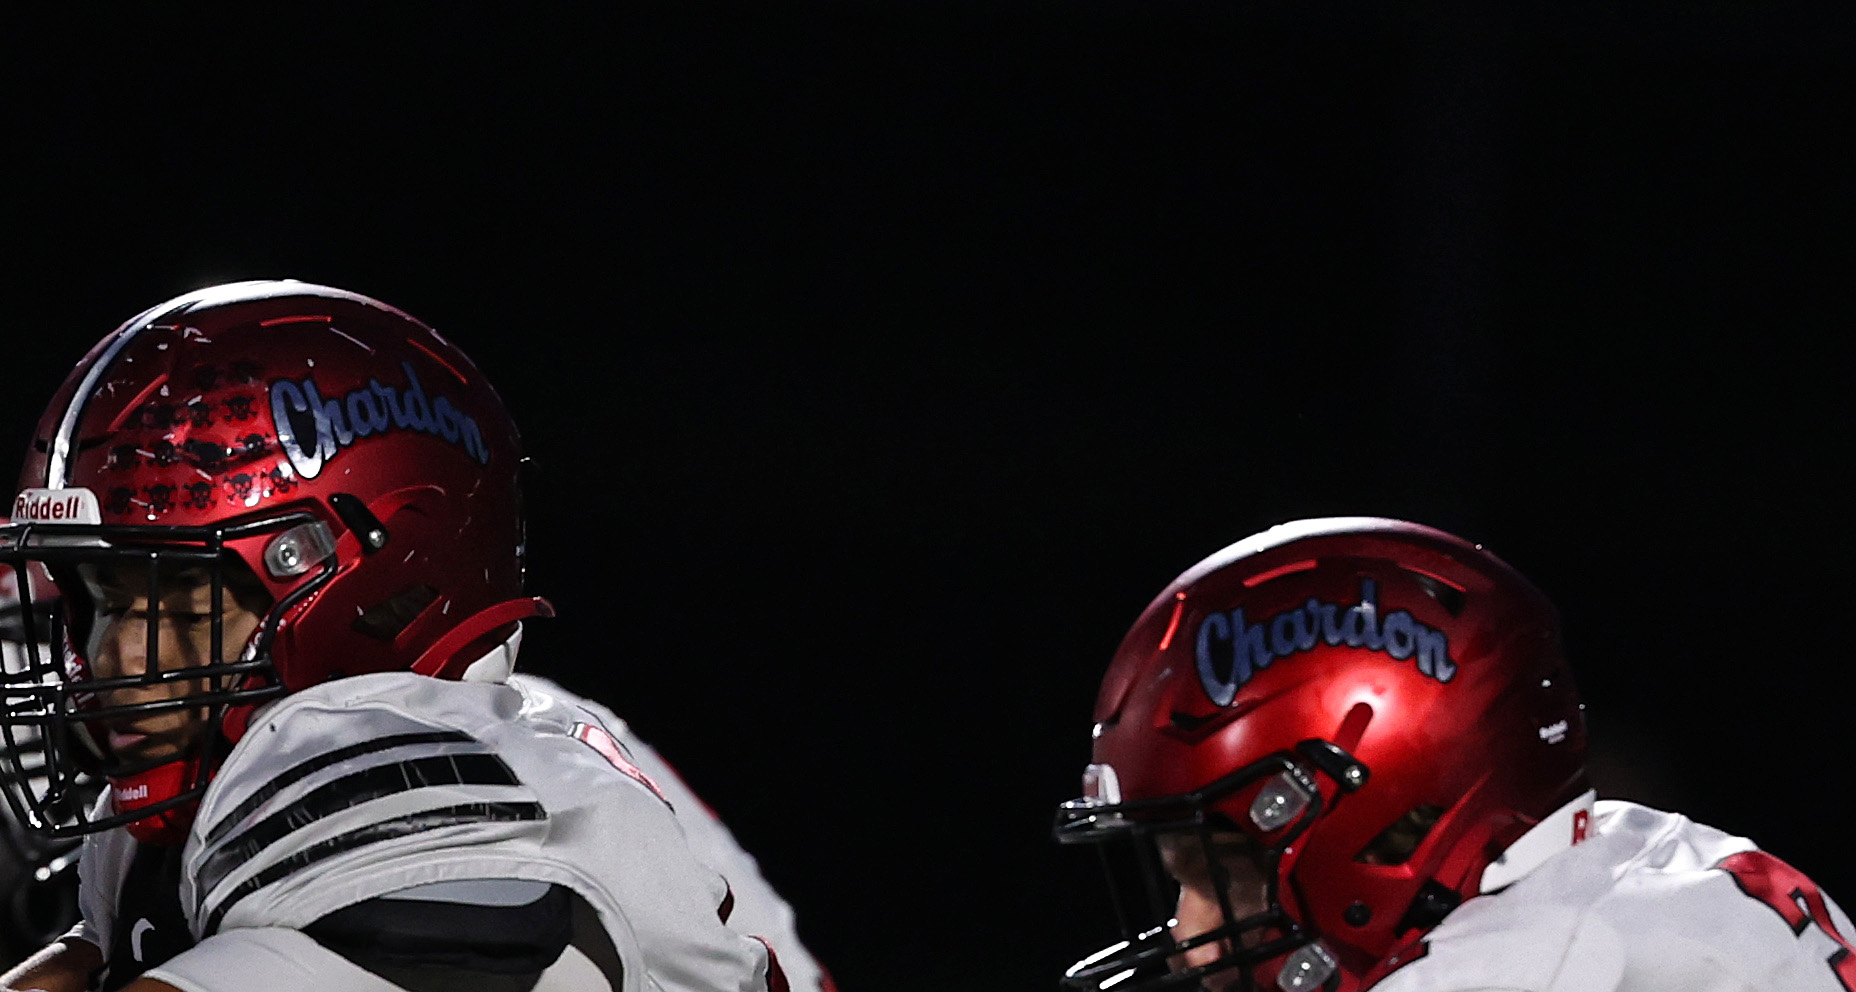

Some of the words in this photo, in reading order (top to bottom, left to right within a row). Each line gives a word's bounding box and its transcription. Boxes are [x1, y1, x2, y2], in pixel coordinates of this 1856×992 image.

[269, 360, 490, 480] Chardon
[16, 496, 80, 520] Riddell
[1196, 577, 1457, 707] Chardon
